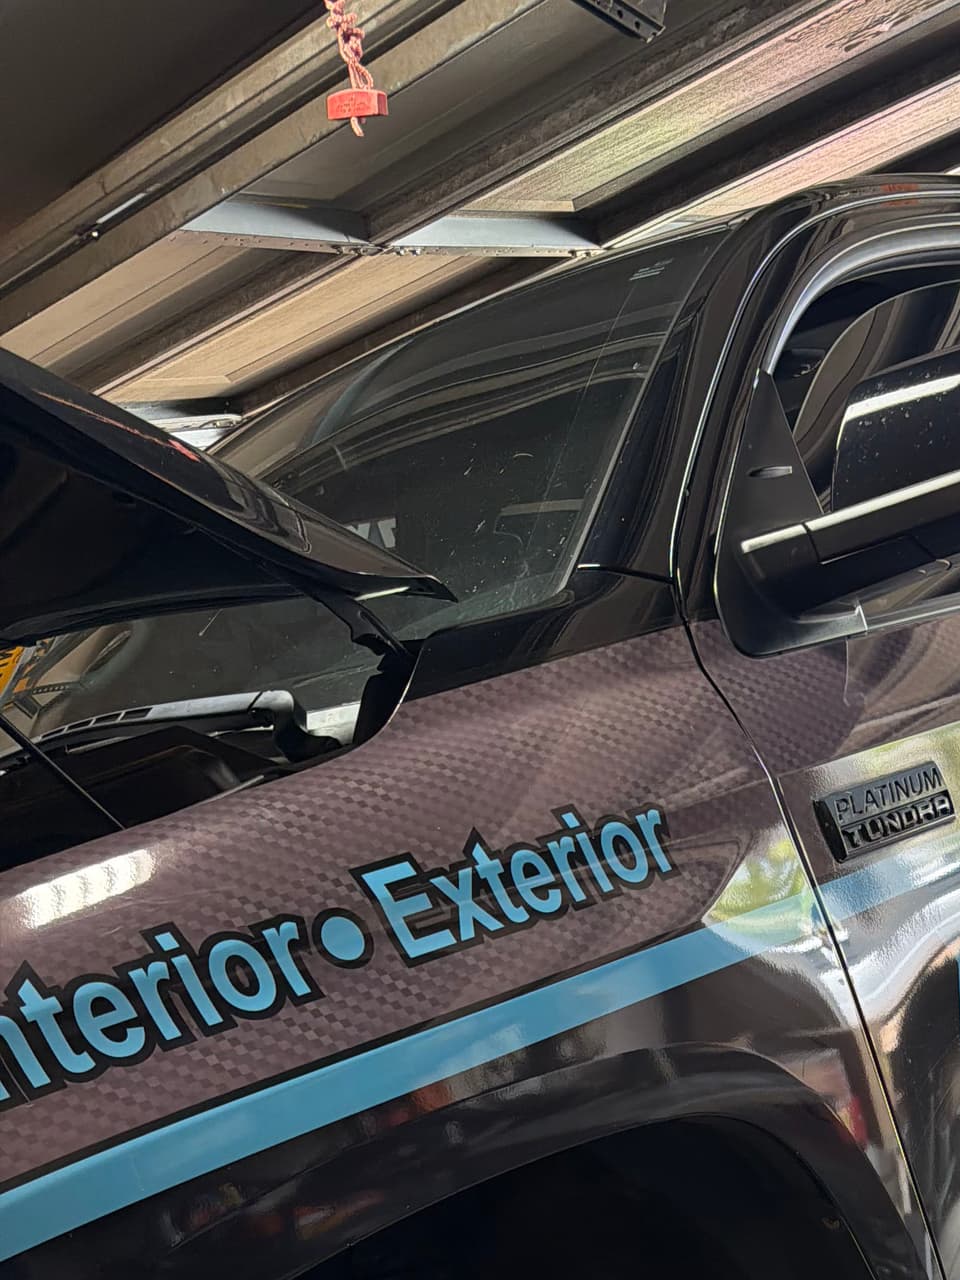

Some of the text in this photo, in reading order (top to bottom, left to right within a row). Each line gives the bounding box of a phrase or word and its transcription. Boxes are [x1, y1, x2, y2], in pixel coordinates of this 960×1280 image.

[834, 766, 942, 821] PLATINUM
[842, 794, 951, 849] TUNDRA
[0, 806, 674, 1101] nterior Exterior
